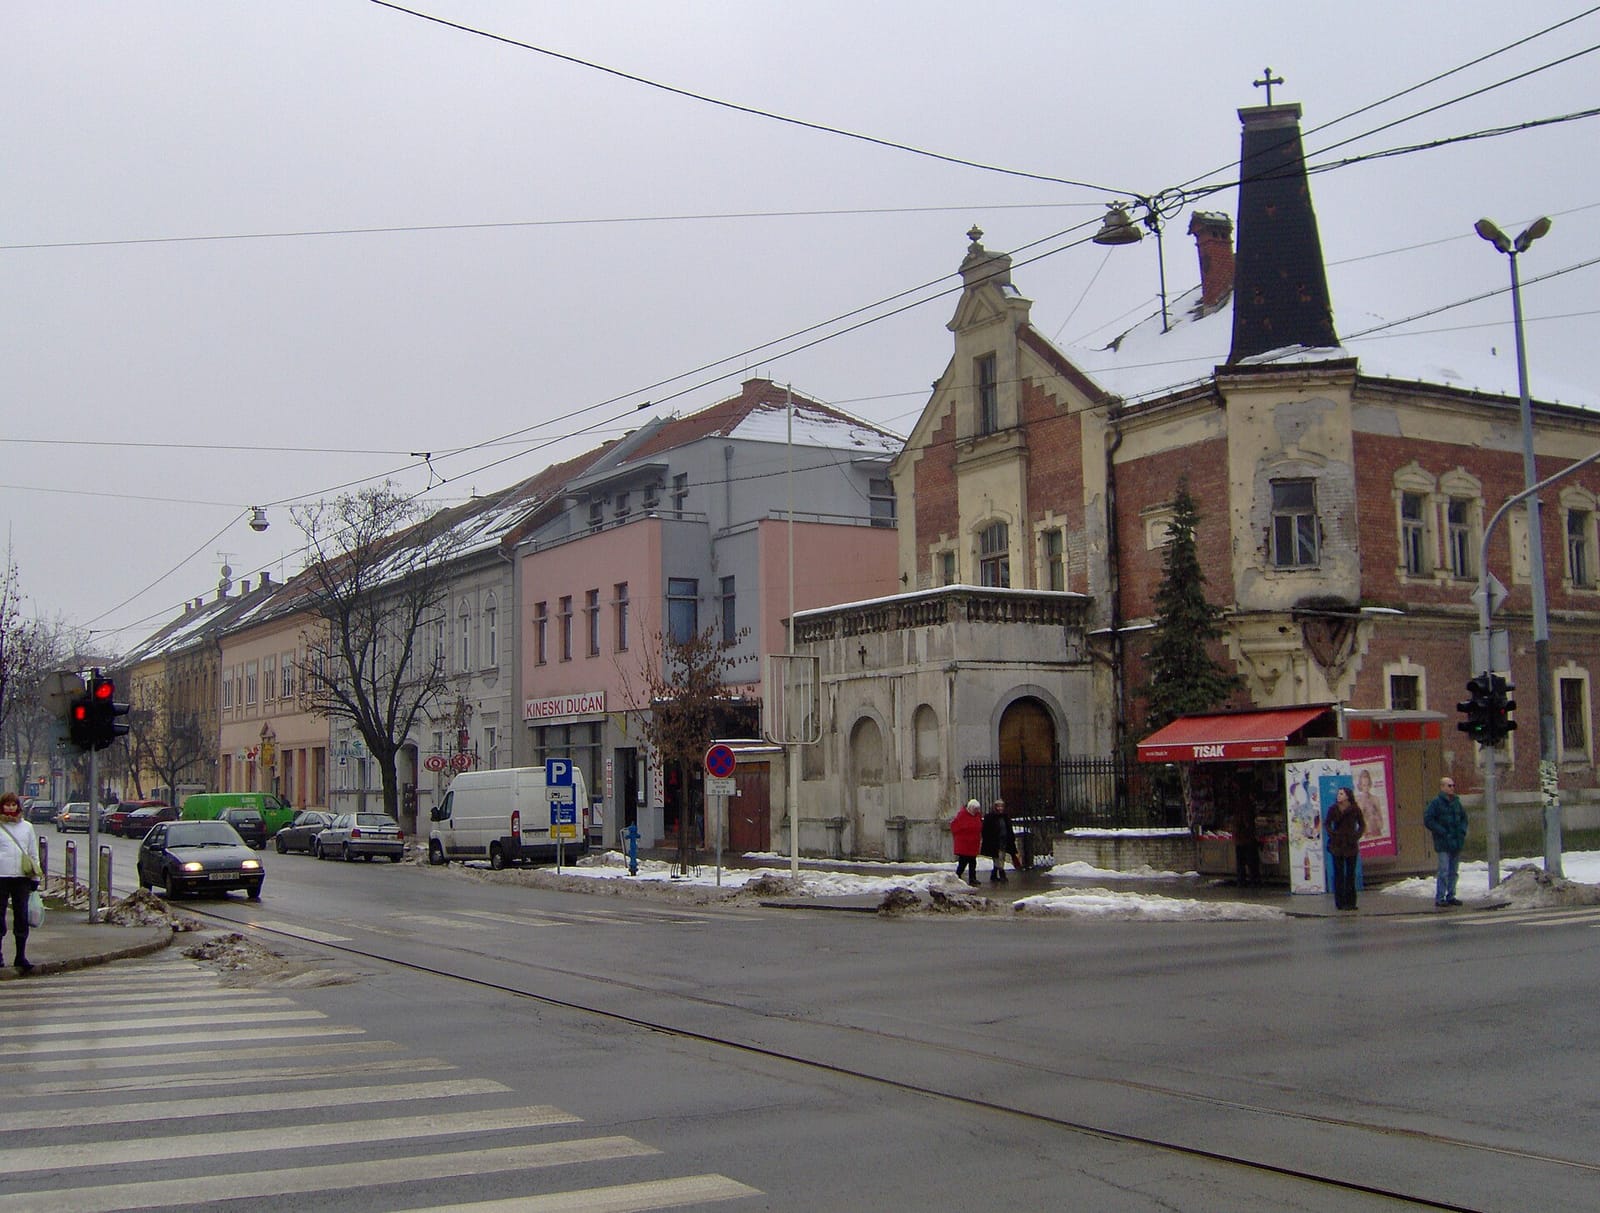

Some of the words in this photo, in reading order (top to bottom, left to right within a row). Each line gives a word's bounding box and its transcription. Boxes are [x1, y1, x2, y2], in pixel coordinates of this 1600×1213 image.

[526, 701, 563, 717] KINESKI
[566, 695, 603, 713] DUĆAN
[1192, 745, 1225, 758] TISAK
[552, 762, 566, 783] P
